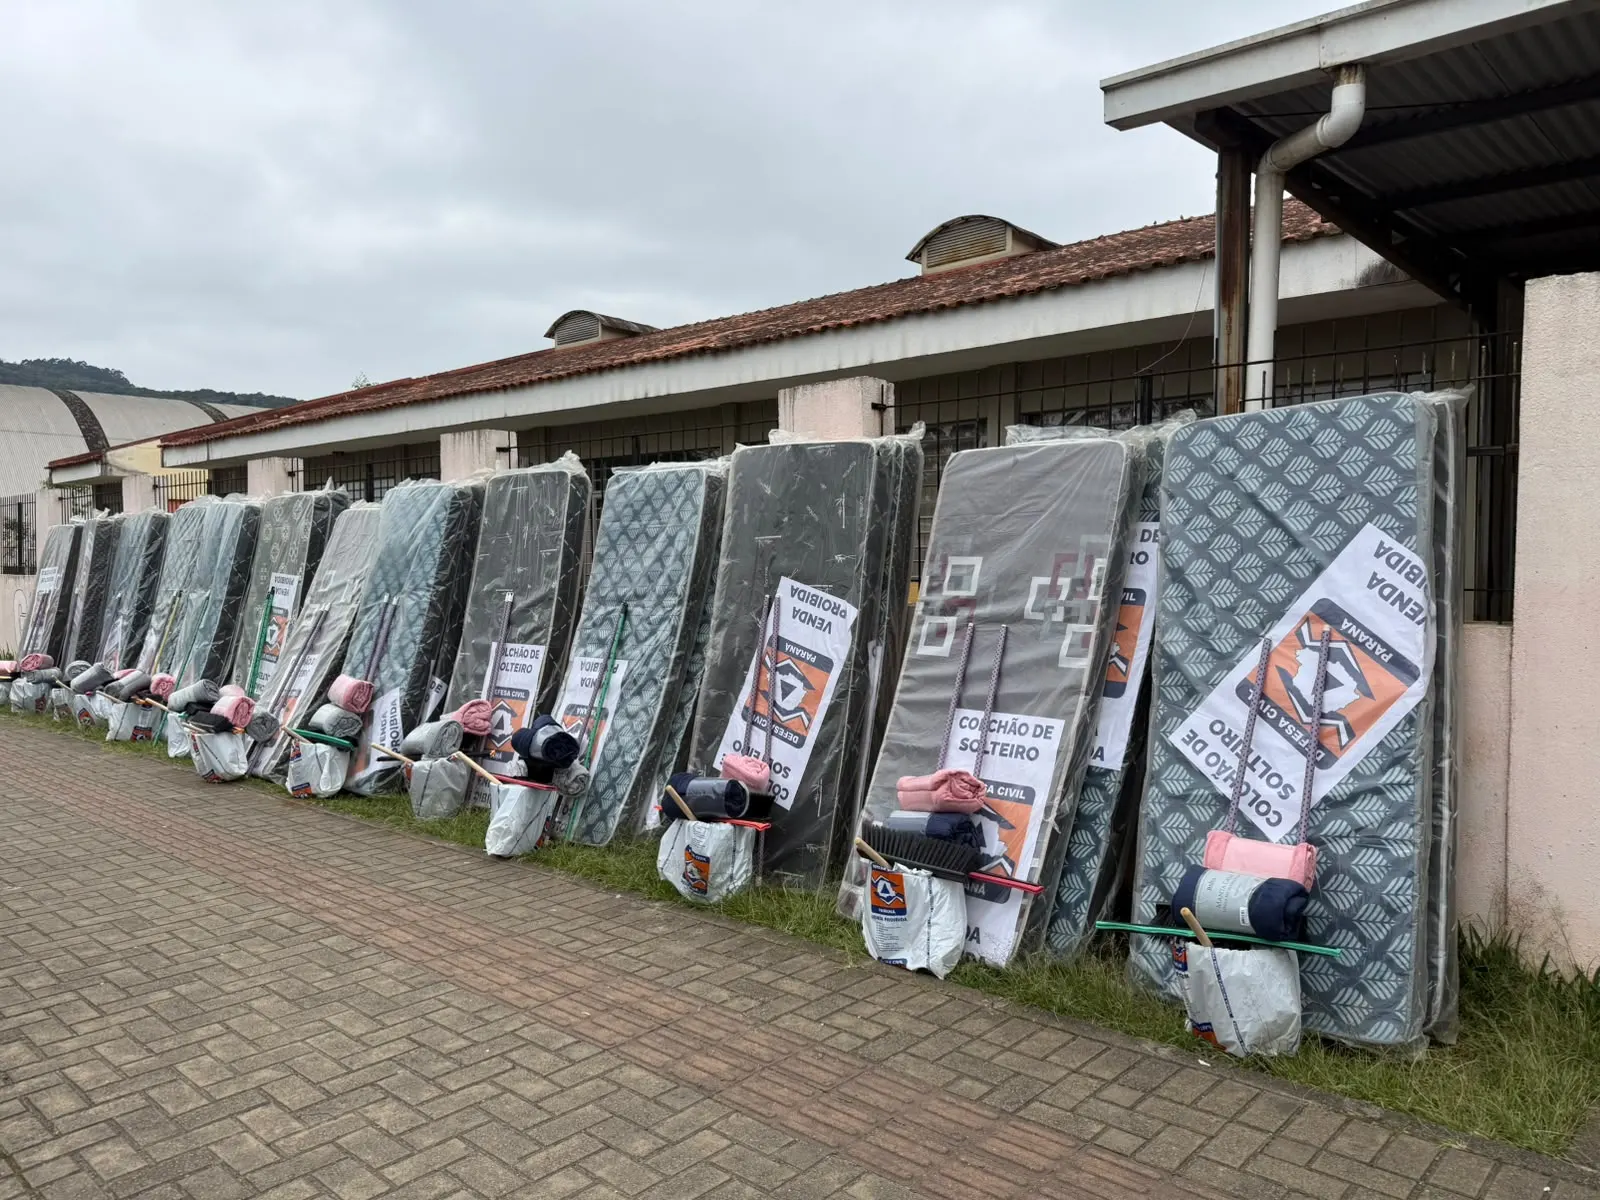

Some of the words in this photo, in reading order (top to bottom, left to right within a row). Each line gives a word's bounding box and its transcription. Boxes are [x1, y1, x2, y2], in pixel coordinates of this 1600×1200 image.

[790, 585, 847, 619] PROIBIDA
[792, 606, 832, 635] VENDA
[785, 642, 817, 663] PARANÁ
[1340, 618, 1394, 663] PARANÁ
[530, 649, 540, 660] DE
[500, 662, 533, 674] OLTEIRO
[581, 661, 619, 674] PBIDA
[390, 698, 401, 754] PROIBIDA
[772, 723, 799, 744] DEFES
[959, 716, 1029, 737] COCHÃO
[1032, 724, 1055, 740] DE
[1181, 729, 1209, 756] DE
[1278, 717, 1326, 762] DFESA
[997, 786, 1026, 800] CIVIL
